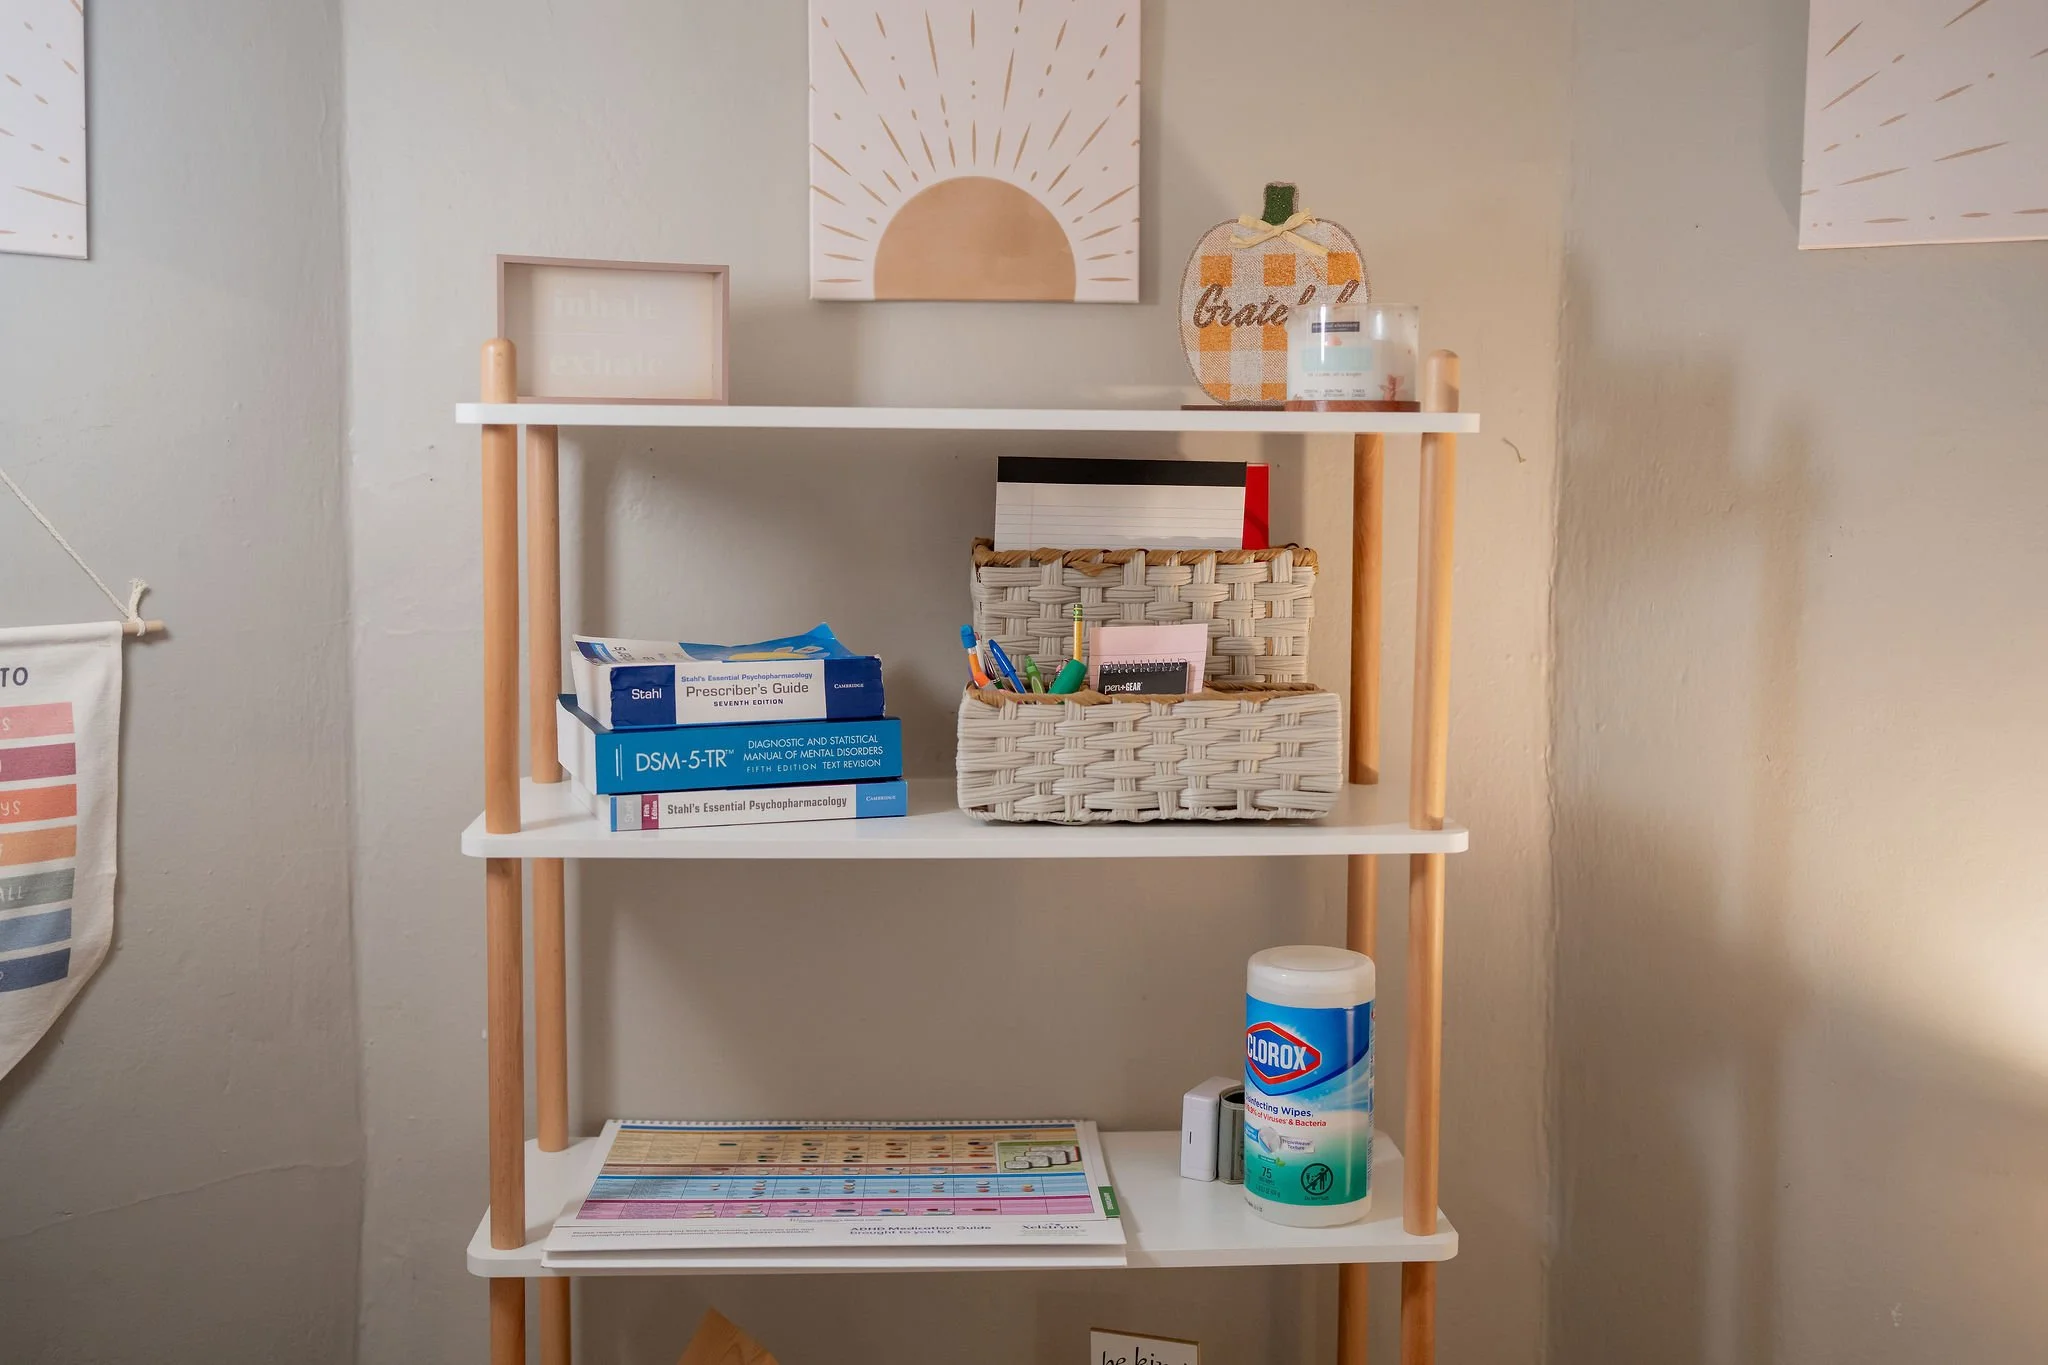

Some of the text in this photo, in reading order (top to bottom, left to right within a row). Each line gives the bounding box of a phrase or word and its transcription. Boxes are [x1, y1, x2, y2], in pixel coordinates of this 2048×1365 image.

[681, 672, 813, 683] Stahl's Essential Psychopharmacology
[631, 688, 662, 700] Stahl
[686, 681, 809, 697] Prescriber's Guide
[713, 698, 784, 707] SEVENTH EDITION
[748, 734, 878, 750] DIAGNOSTIC AND STATISTICAL
[743, 746, 884, 761] MANUAL OF MENTAL DISORDERS
[746, 759, 881, 773] FIFTH EDITION TEXT REVISION
[667, 796, 847, 815] Stahl's Essential Psychopharmacology
[1247, 1033, 1306, 1070] CLOROX
[1295, 1119, 1327, 1127] Bacteria
[1262, 1166, 1272, 1179] 75
[1135, 1347, 1187, 1365] ki
